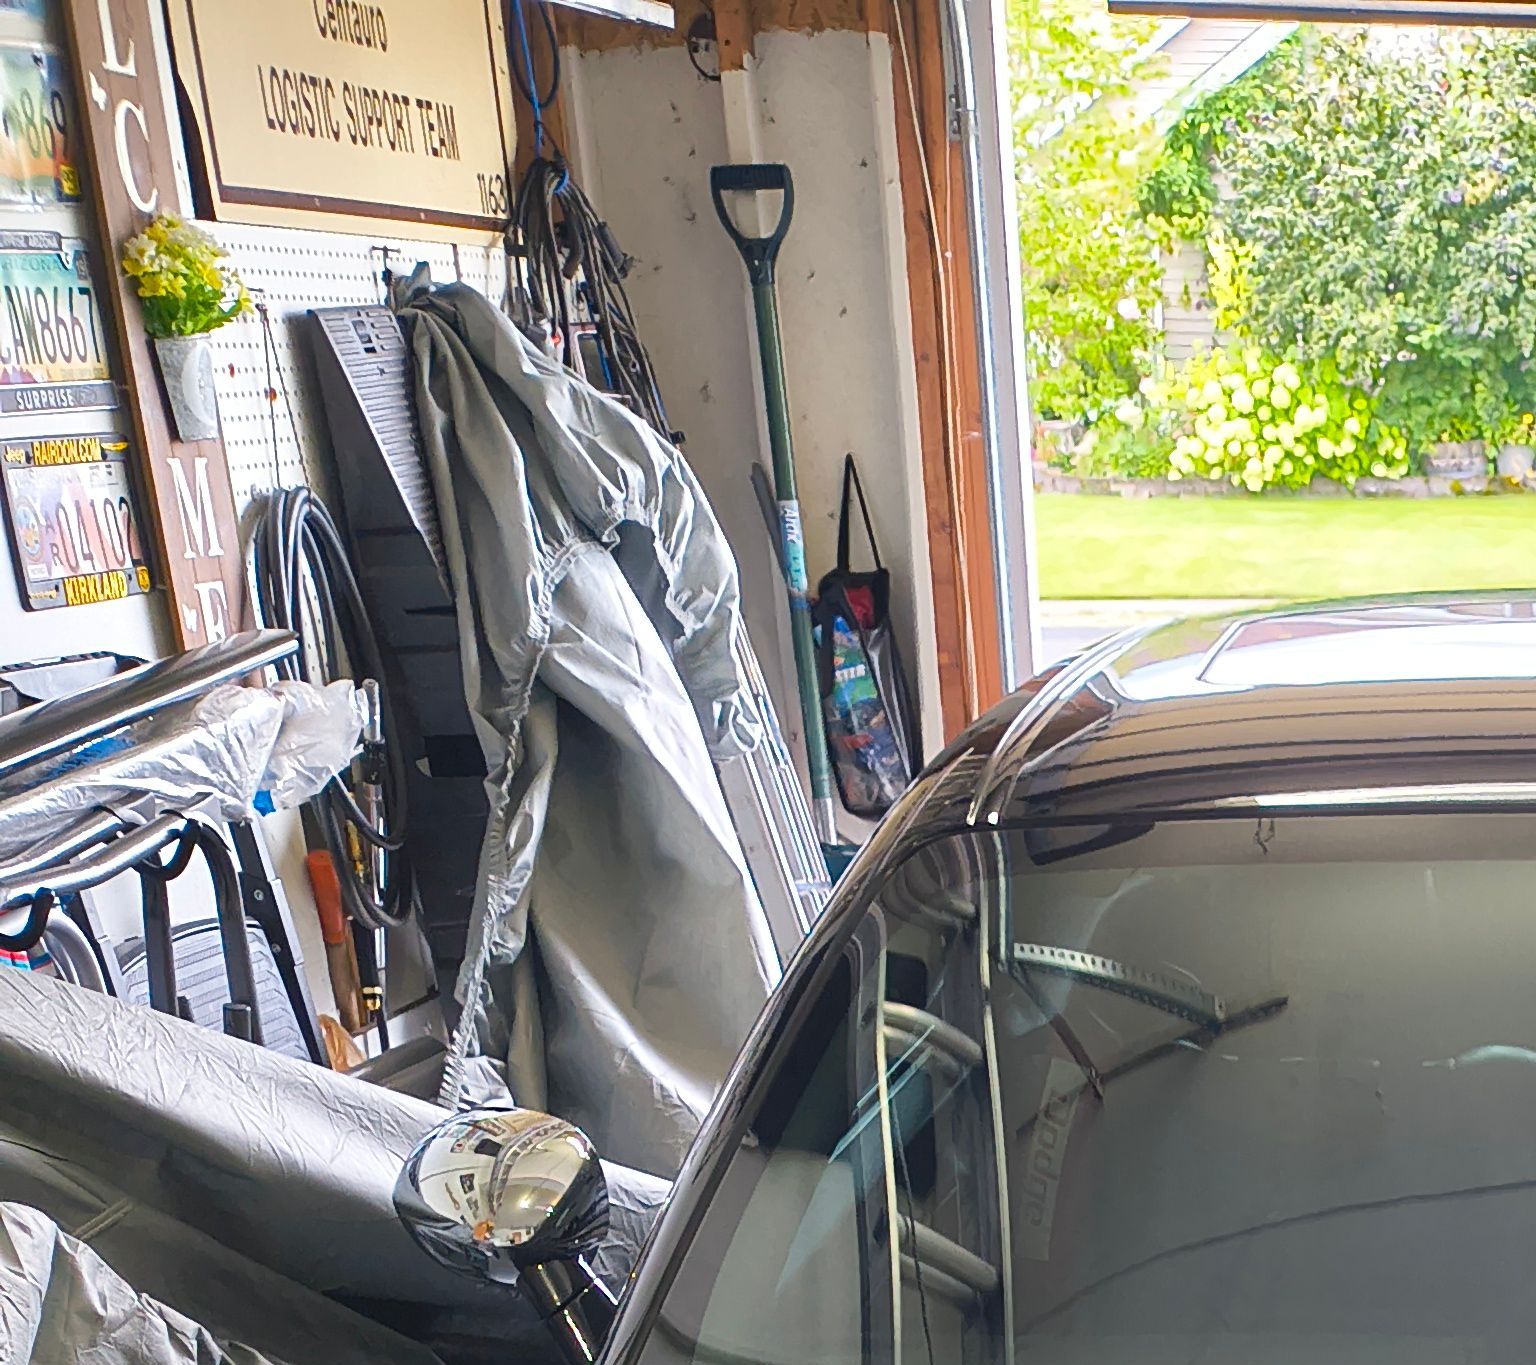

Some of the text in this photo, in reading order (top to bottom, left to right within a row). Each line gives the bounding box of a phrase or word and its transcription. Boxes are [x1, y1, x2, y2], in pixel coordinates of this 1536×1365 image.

[313, 0, 388, 52] Centauro
[257, 64, 460, 161] LOGISTIC SUPPORT TEAM
[476, 172, 508, 215] 1163
[0, 285, 101, 365] AW8667
[16, 387, 74, 410] SURPRISE
[4, 437, 102, 466] Jeep RAIRDON.COM
[64, 570, 128, 607] KIRKLAND
